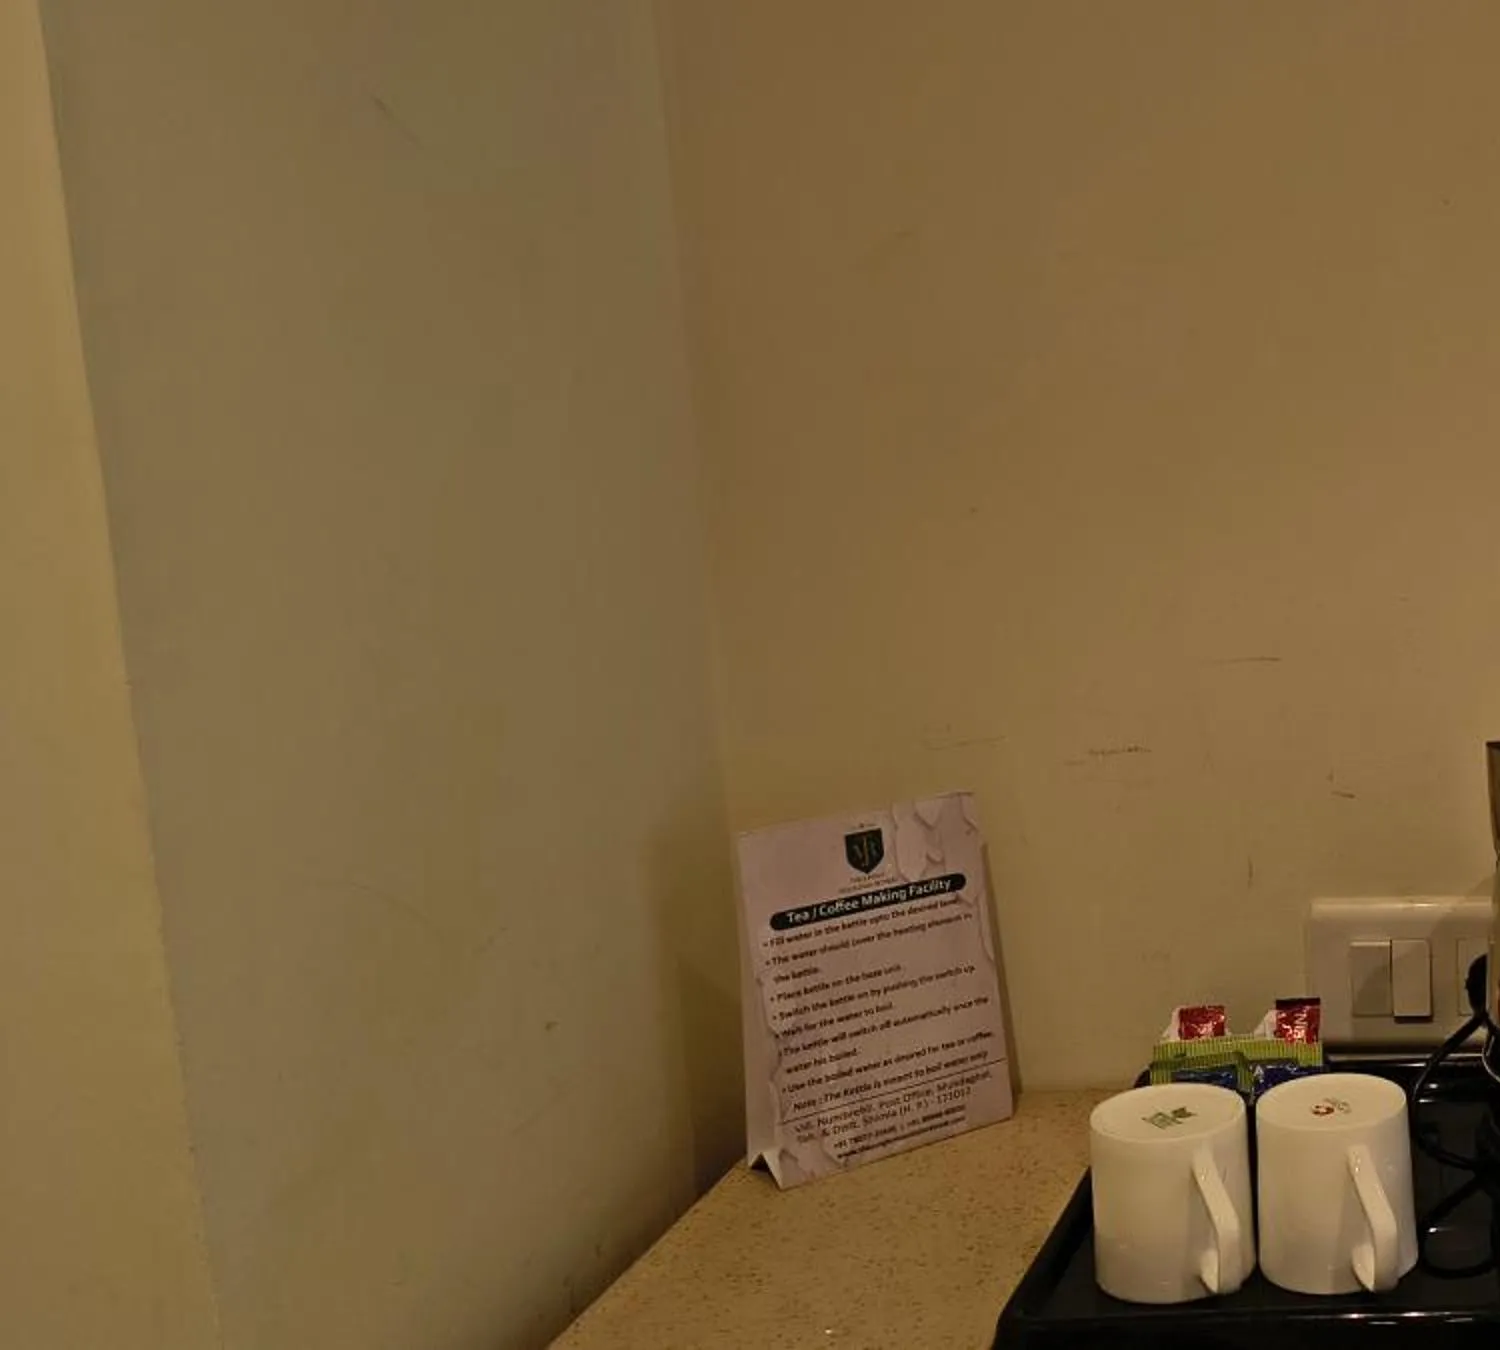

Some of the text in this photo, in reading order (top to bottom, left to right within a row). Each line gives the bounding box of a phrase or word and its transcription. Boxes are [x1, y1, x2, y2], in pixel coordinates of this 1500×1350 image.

[769, 935, 785, 946] Fill
[785, 929, 812, 943] water
[813, 927, 822, 937] in
[824, 923, 840, 935] the
[840, 917, 867, 930] kettle
[891, 908, 906, 918] the
[907, 900, 938, 915] desired
[786, 907, 809, 923] Tea
[818, 896, 859, 916] Coffee
[861, 886, 906, 909] Making
[908, 876, 952, 899] Facility
[771, 911, 972, 965] The water should cover the heating element in
[772, 972, 790, 983] the
[776, 988, 802, 1001] Place
[802, 980, 830, 994] kettle
[831, 978, 843, 988] on
[844, 972, 860, 984] the
[861, 967, 882, 980] base
[778, 1004, 810, 1020] Switch
[811, 999, 827, 1011] the
[829, 993, 855, 1007] kettle
[856, 990, 868, 1000] on
[869, 987, 882, 1000] by
[883, 977, 918, 995] pushing
[918, 973, 934, 984] the
[934, 965, 963, 979] switch
[781, 1024, 802, 1037] Wait
[803, 1021, 817, 1032] for
[818, 1016, 834, 1028] the
[835, 1010, 862, 1024] water
[862, 1007, 874, 1017] to
[783, 994, 988, 1055] The kettle will switch off automatically once the
[785, 1059, 812, 1074] water
[787, 1080, 805, 1093] Use
[807, 1076, 823, 1088] the
[824, 1066, 853, 1083] boiled
[855, 1060, 881, 1075] water
[882, 1057, 892, 1067] as
[893, 1047, 926, 1063] desired
[927, 1043, 939, 1053] for
[941, 1039, 955, 1050] tea
[956, 1037, 964, 1046] or
[793, 1097, 816, 1112] Note
[824, 1090, 841, 1103] The
[843, 1081, 871, 1097] Kettle
[883, 1071, 912, 1086] meant
[913, 1067, 925, 1078] to
[925, 1061, 941, 1074] boil
[943, 1056, 968, 1069] water
